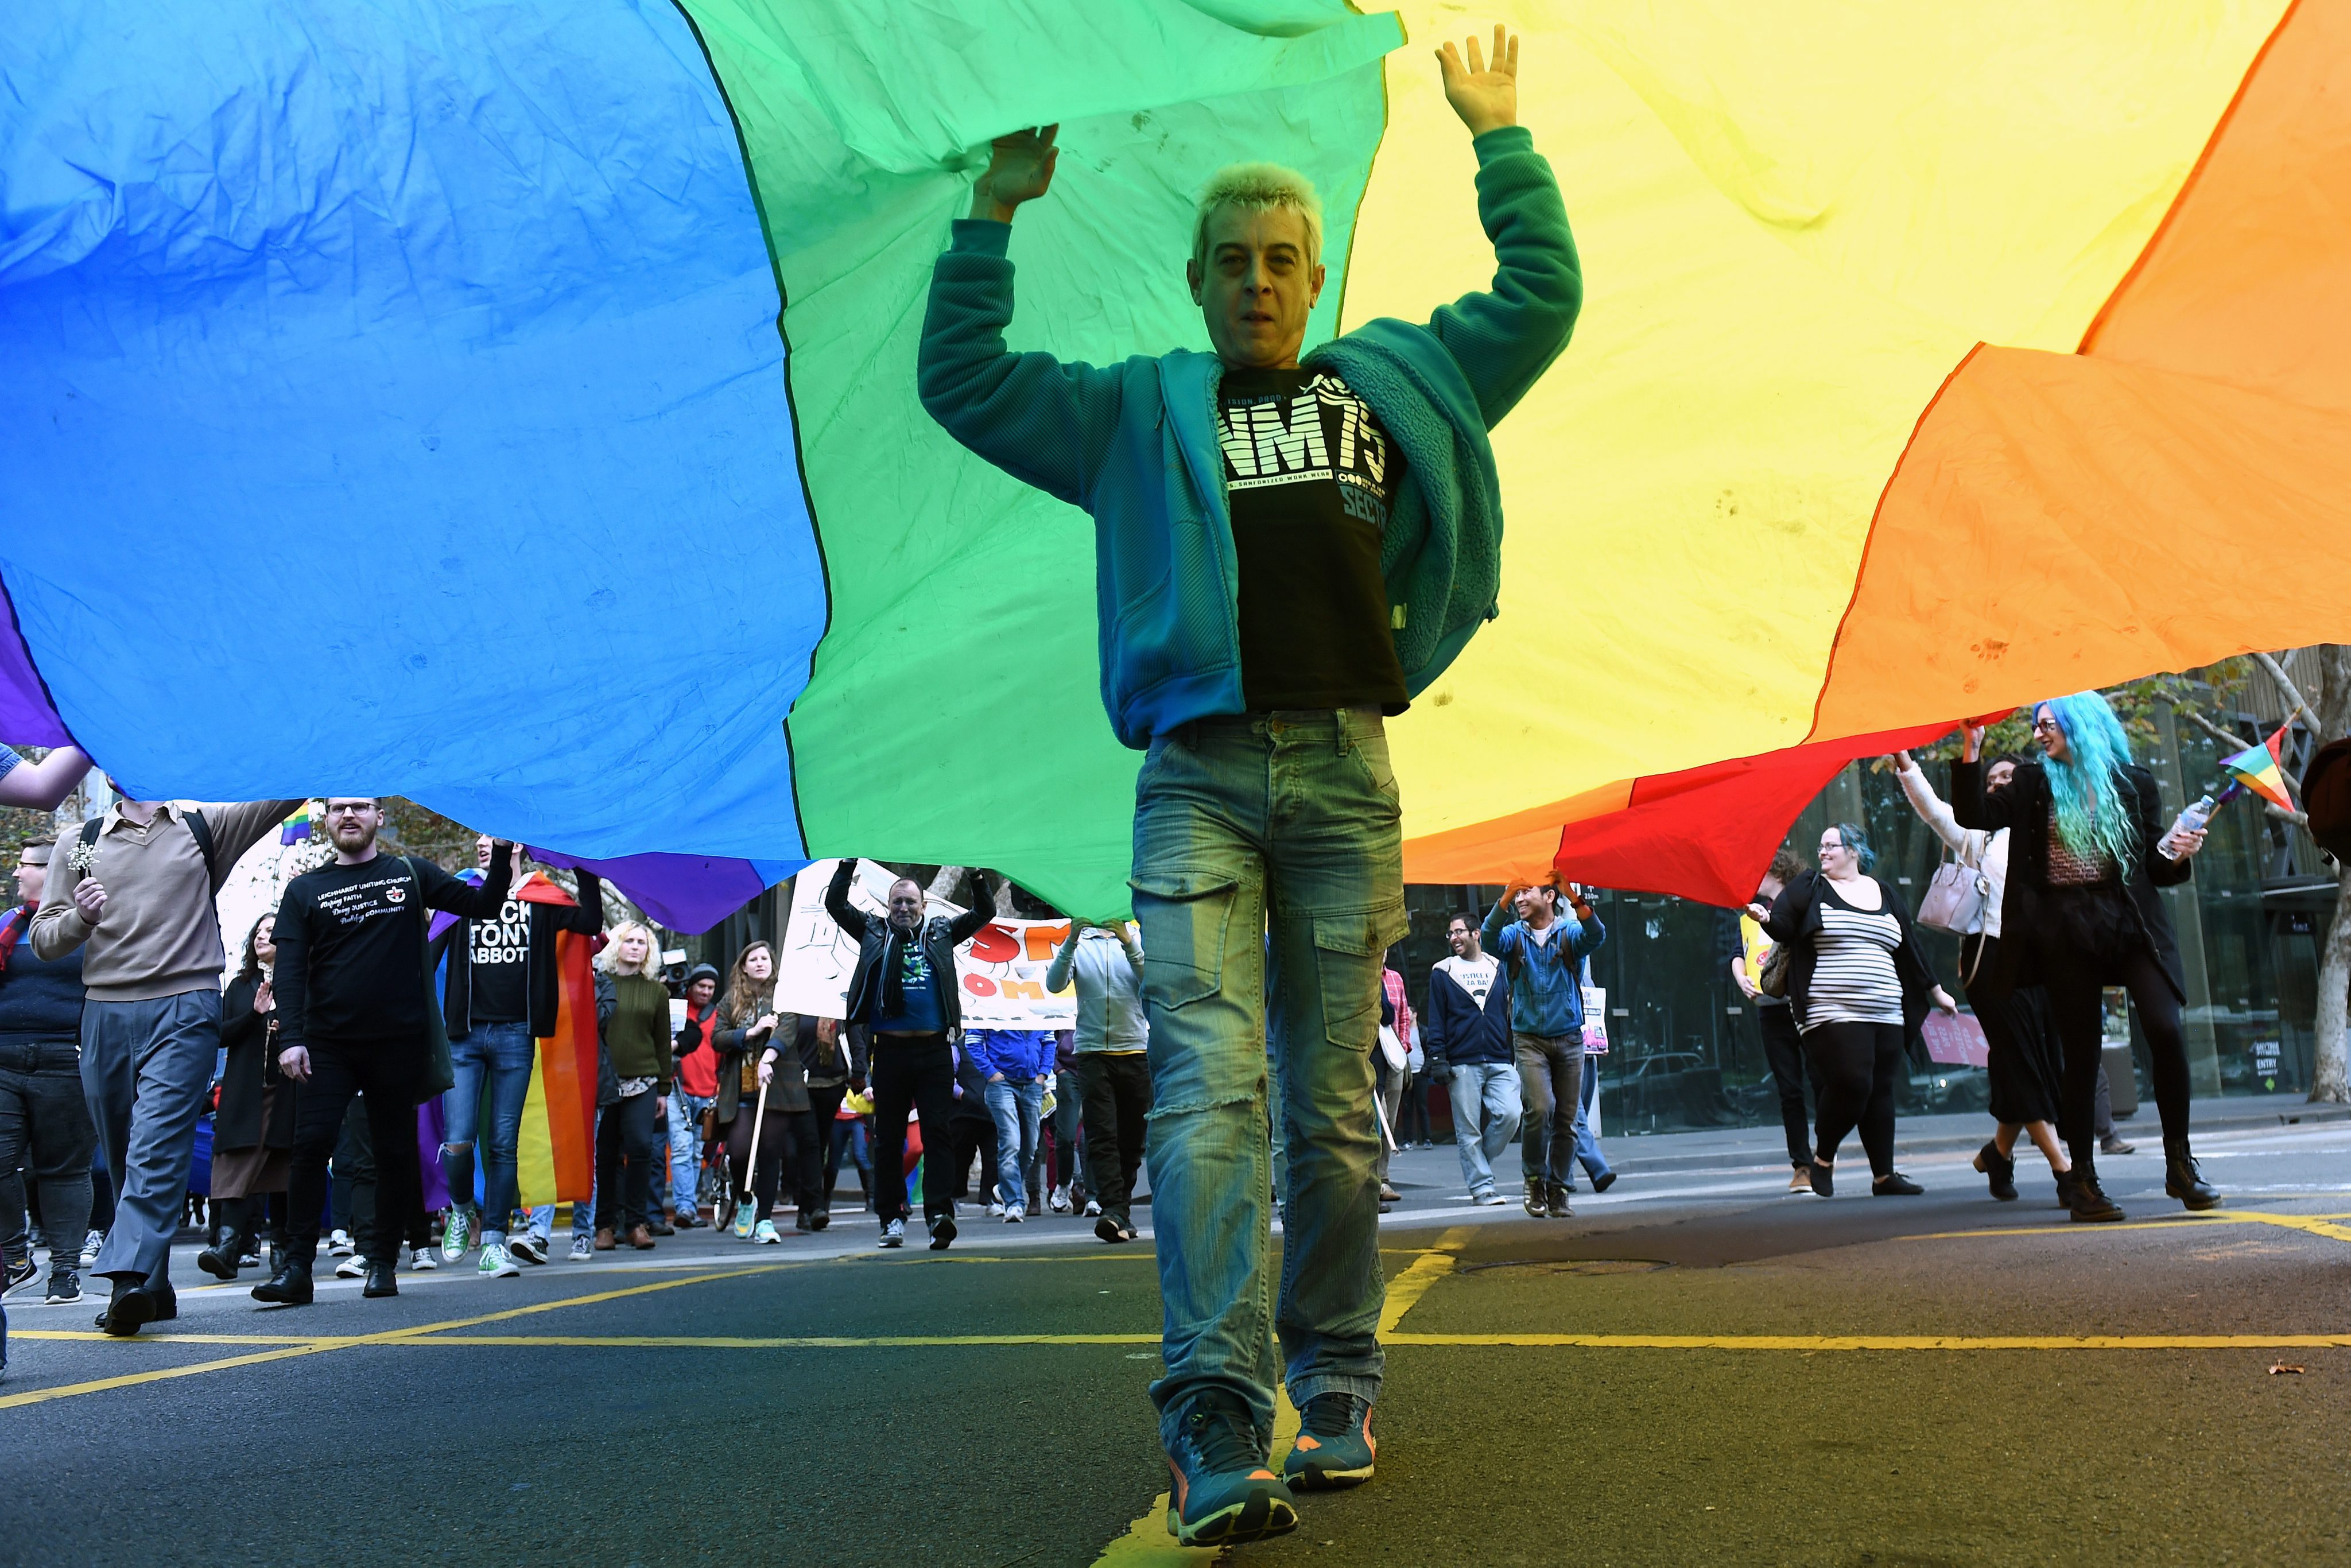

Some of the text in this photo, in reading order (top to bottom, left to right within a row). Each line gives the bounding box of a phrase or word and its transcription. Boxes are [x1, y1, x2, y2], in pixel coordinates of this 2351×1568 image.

[1238, 478, 1283, 487] SANFORIZED
[317, 876, 412, 901] LEICHHARDT UNITING CHURCH
[343, 894, 362, 902] FAITH
[351, 899, 378, 911] JUSTICE
[365, 906, 405, 917] COMMUNITY
[471, 923, 529, 946] TONY
[2257, 1058, 2277, 1069] ENTRY
